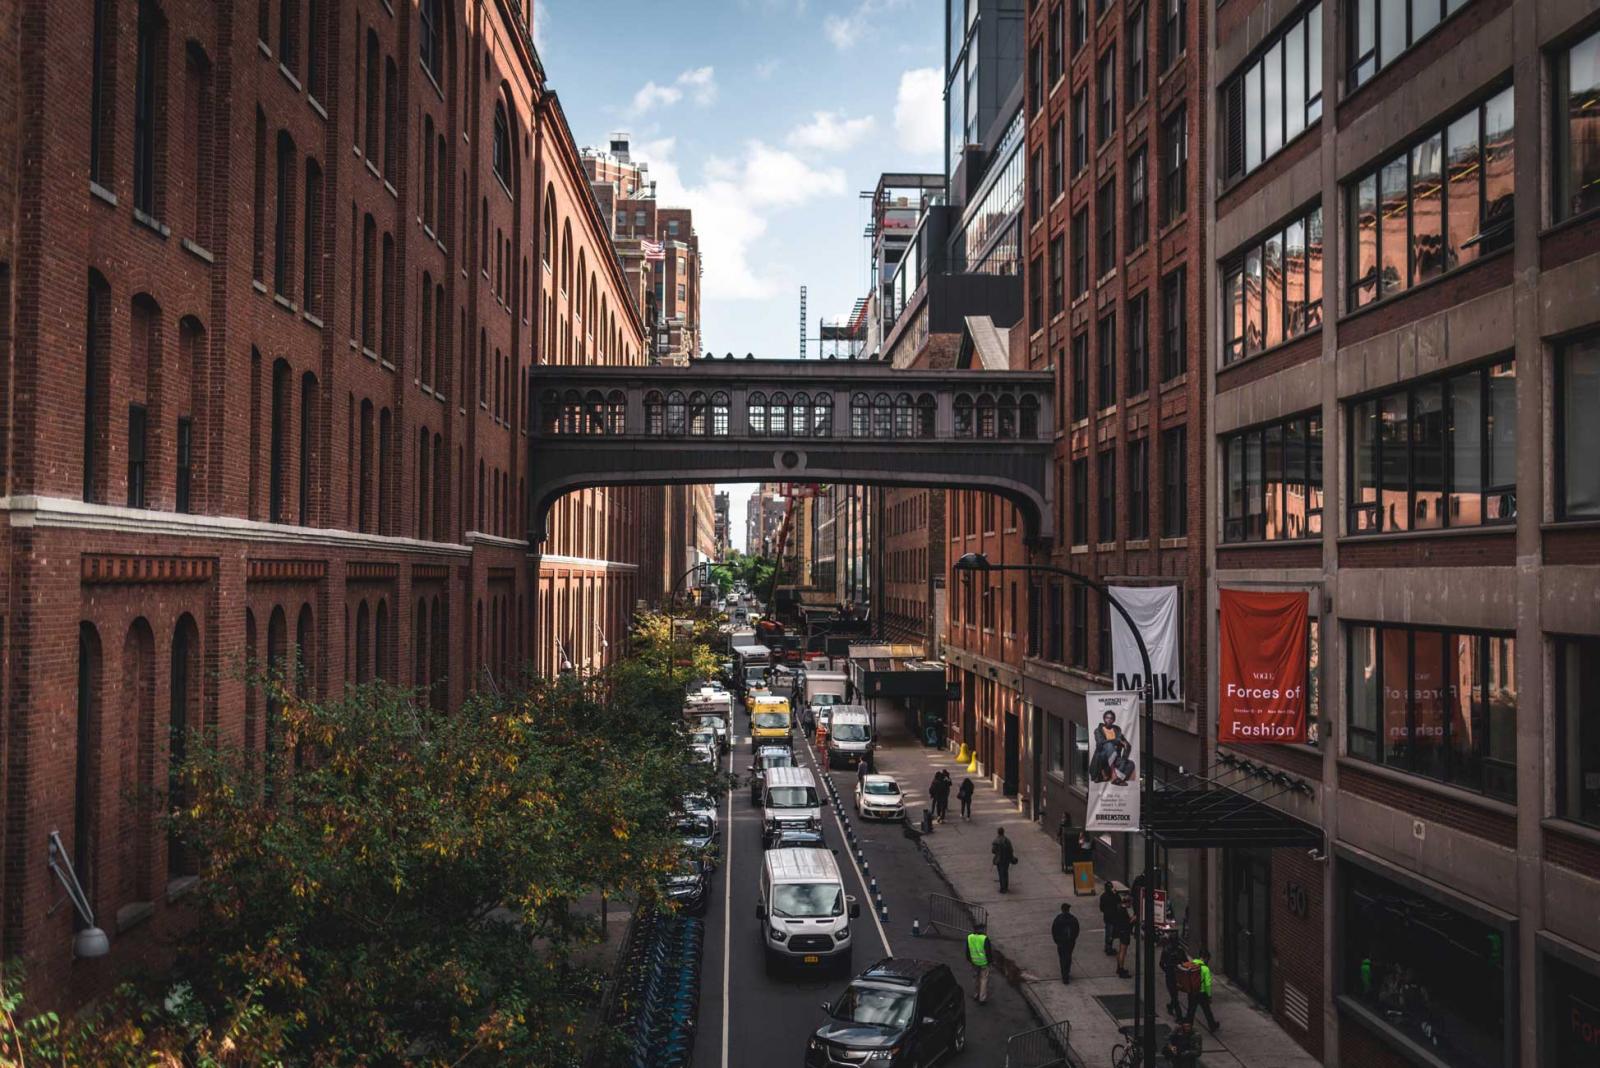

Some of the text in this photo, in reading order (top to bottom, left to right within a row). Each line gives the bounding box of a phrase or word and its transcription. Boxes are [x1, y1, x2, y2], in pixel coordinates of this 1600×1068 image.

[1117, 673, 1177, 700] Mlk
[1227, 684, 1300, 699] Forces of
[1232, 722, 1295, 736] Fashion
